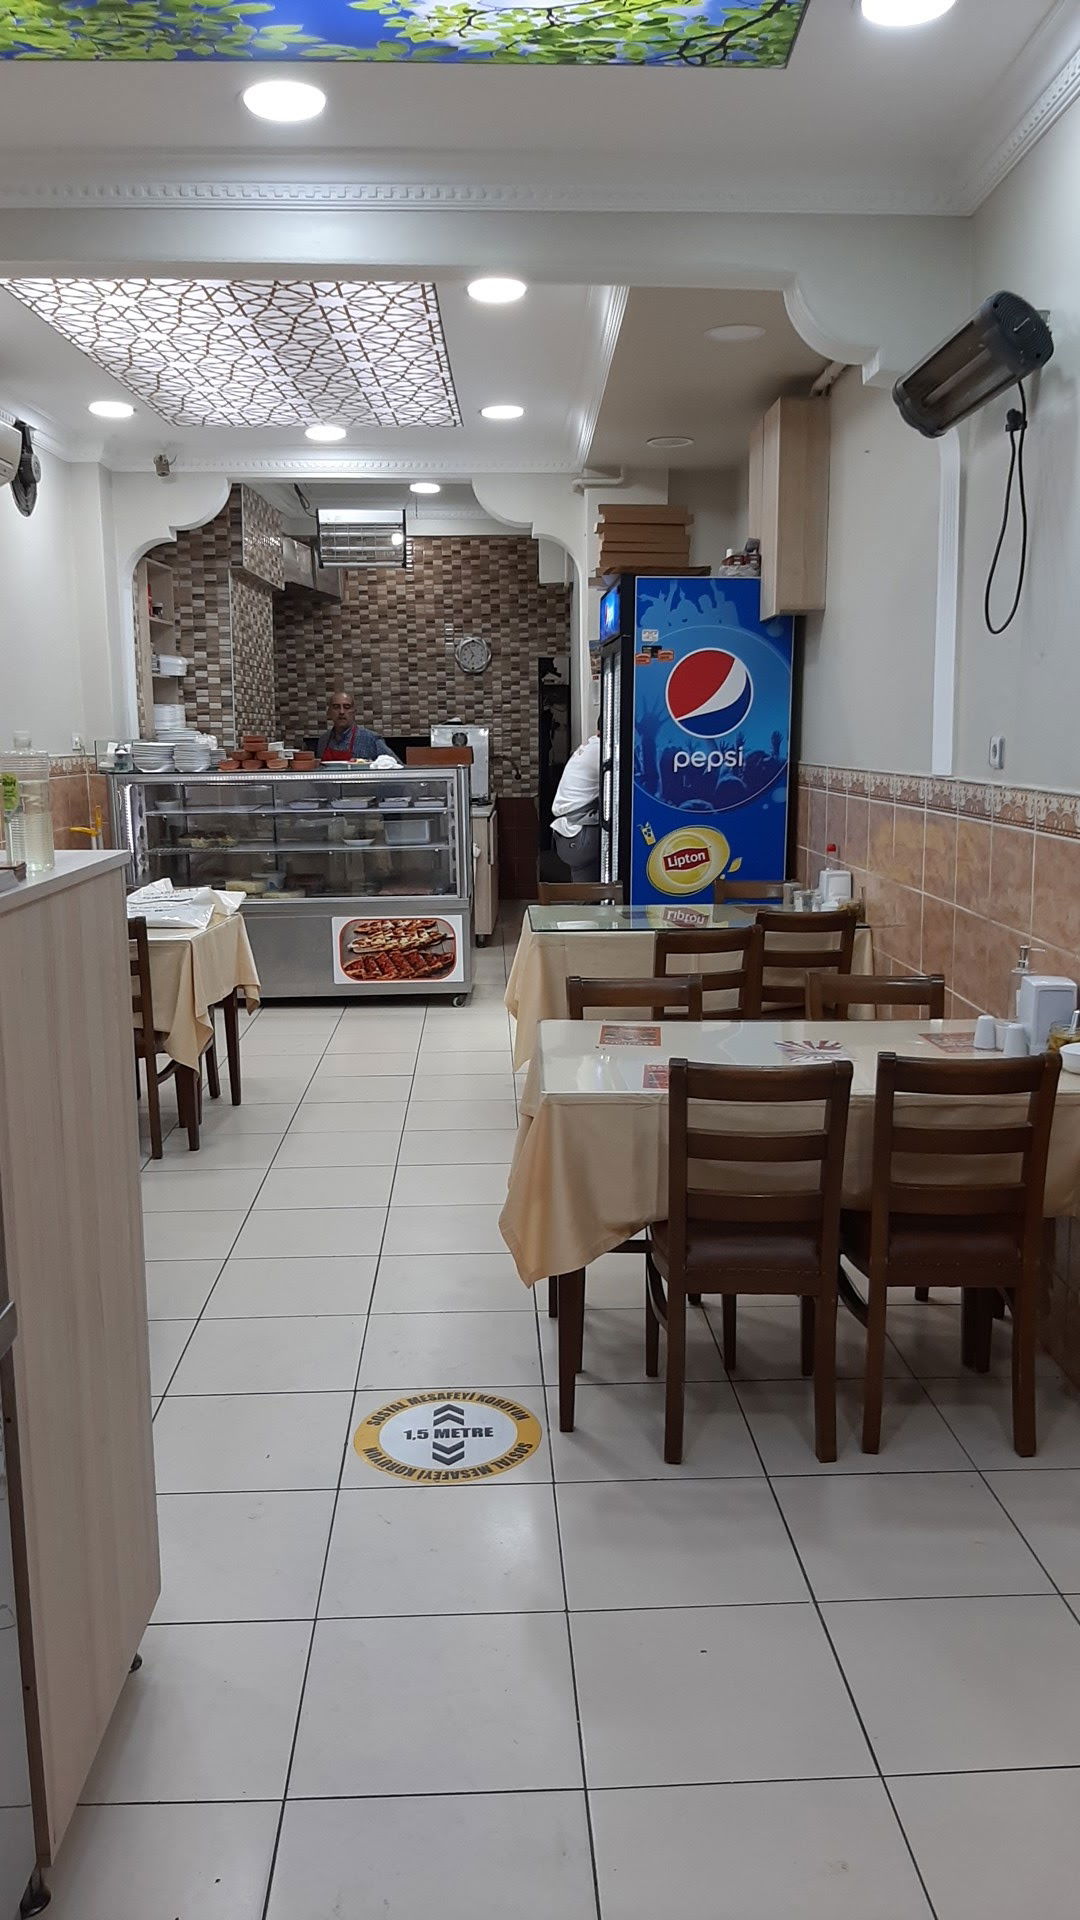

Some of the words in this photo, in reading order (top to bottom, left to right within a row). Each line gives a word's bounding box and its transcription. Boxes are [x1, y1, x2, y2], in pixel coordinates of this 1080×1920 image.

[673, 746, 744, 773] pepsi
[667, 851, 706, 868] Lipton
[366, 1402, 409, 1427] SOSYAL
[407, 1391, 476, 1407] MESAFEYİ
[478, 1393, 531, 1421] KORUYUN
[403, 1428, 429, 1441] 1,5
[433, 1426, 494, 1439] METRE
[362, 1446, 416, 1477] KORUYUN
[491, 1441, 534, 1468] SOSYAL
[417, 1465, 493, 1481] MESAFEYİ
